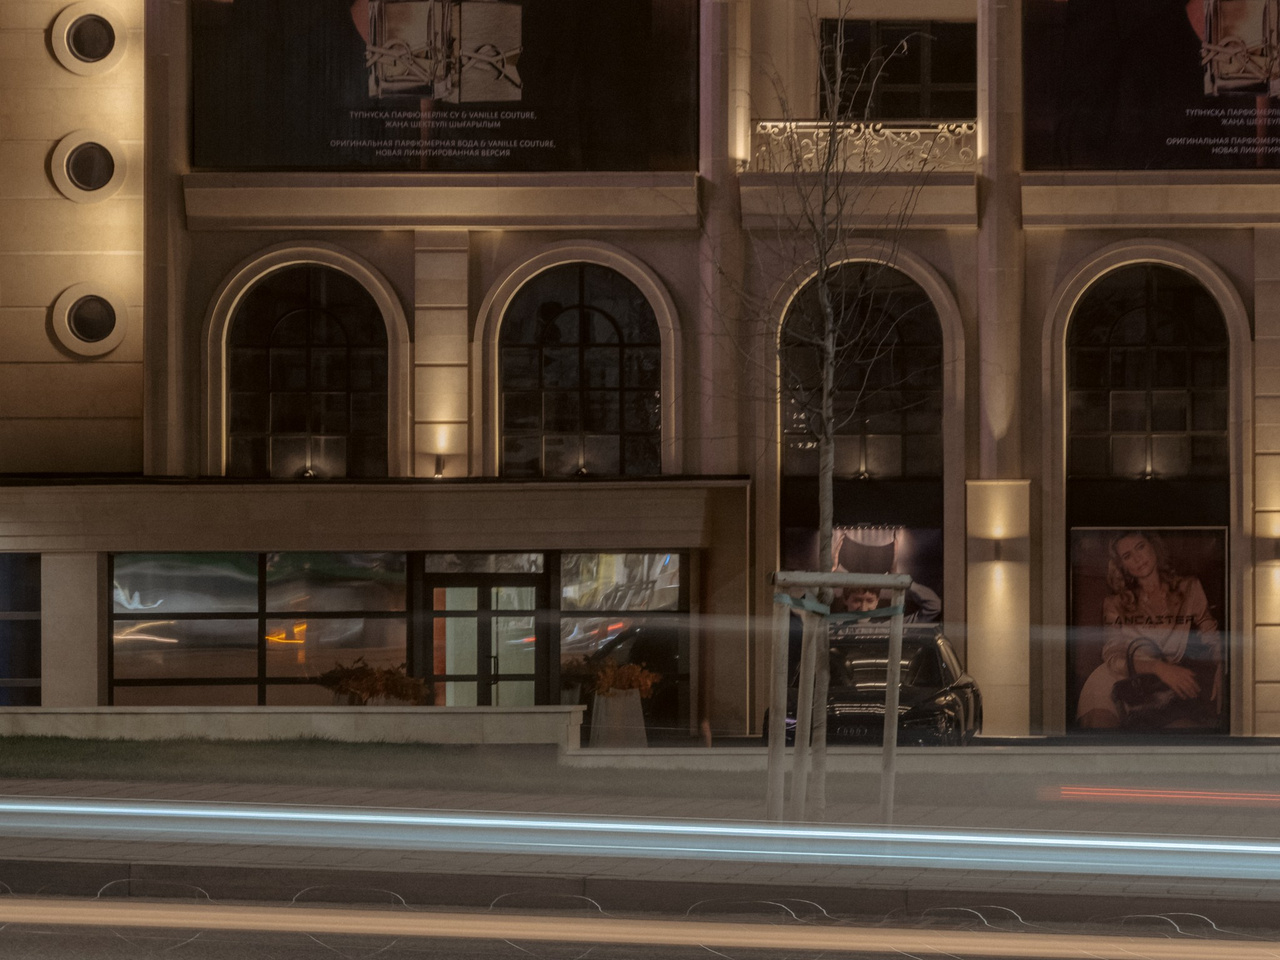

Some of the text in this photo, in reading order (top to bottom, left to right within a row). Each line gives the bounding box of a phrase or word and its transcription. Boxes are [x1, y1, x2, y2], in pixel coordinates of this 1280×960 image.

[469, 111, 498, 119] VANILLE
[330, 139, 392, 147] ОРИГИНАЛЬНАЯ
[395, 139, 455, 147] ПАРФЮМЕРНАЯ
[457, 139, 478, 147] ВОДА
[488, 139, 517, 147] VANILLE
[1166, 137, 1229, 145] ОРИГИНАЛЬНАЯ
[1212, 146, 1238, 154] НОВАЯ
[1103, 615, 1195, 625] LANCASTER
